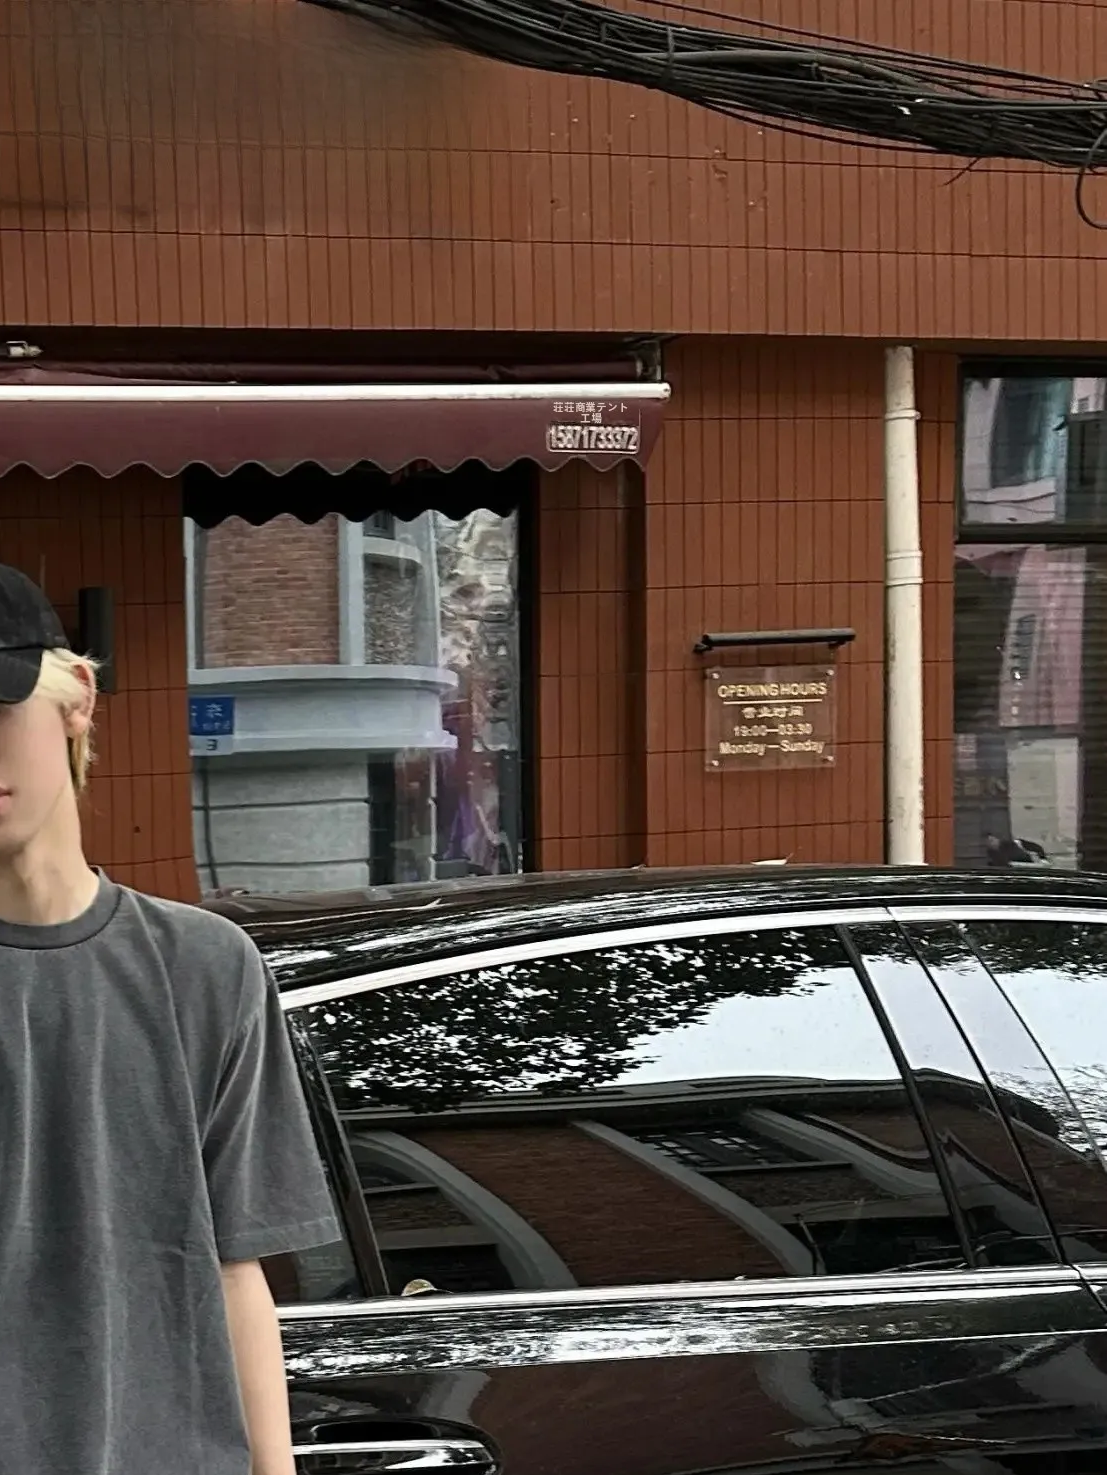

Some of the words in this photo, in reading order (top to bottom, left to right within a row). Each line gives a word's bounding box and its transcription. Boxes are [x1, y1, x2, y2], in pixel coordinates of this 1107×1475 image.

[553, 402, 628, 413] 荘荘商業テント
[580, 413, 602, 424] 工場
